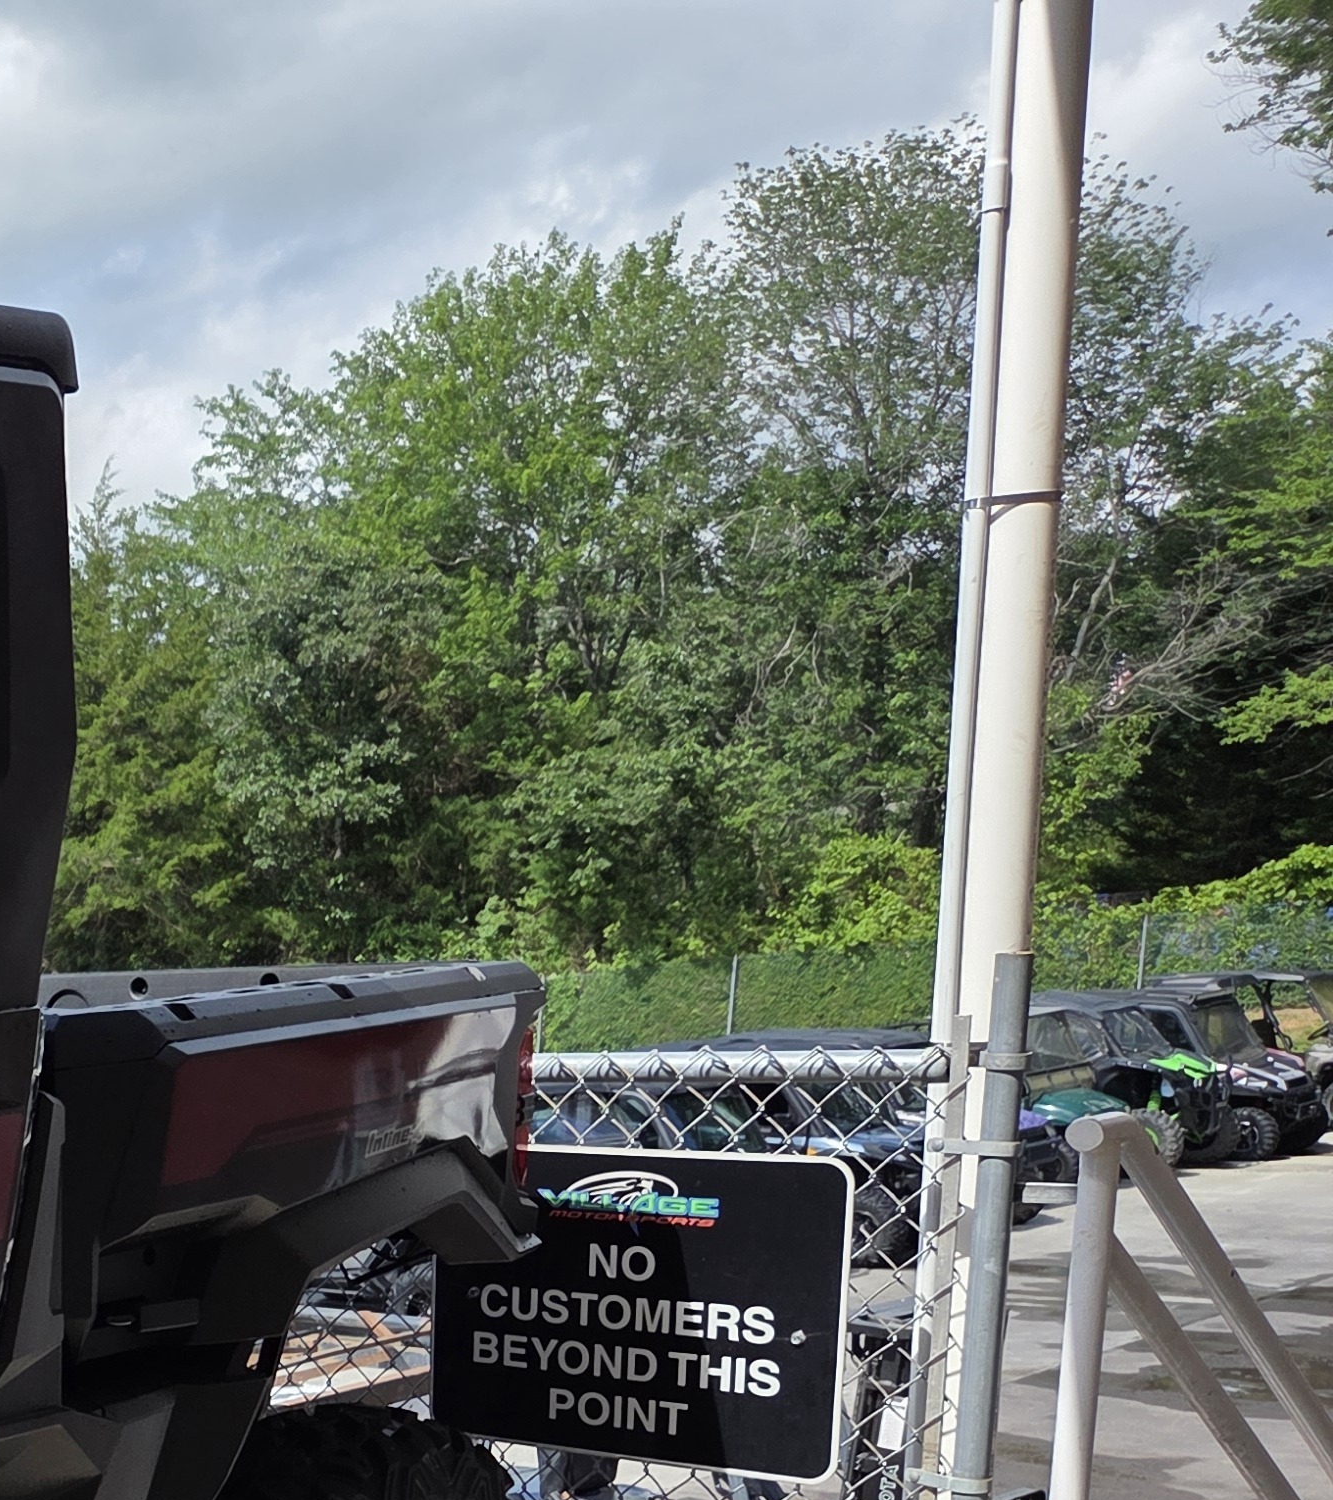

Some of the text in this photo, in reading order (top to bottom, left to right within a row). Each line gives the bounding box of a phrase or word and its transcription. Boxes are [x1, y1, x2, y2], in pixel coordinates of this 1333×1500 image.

[537, 1188, 719, 1218] VILLAGE
[548, 1209, 716, 1228] MOTORSPORTS
[588, 1243, 656, 1282] NO
[479, 1284, 775, 1344] CUSTOMERS
[472, 1331, 781, 1397] BEYOND THIS
[548, 1388, 689, 1436] POINT
